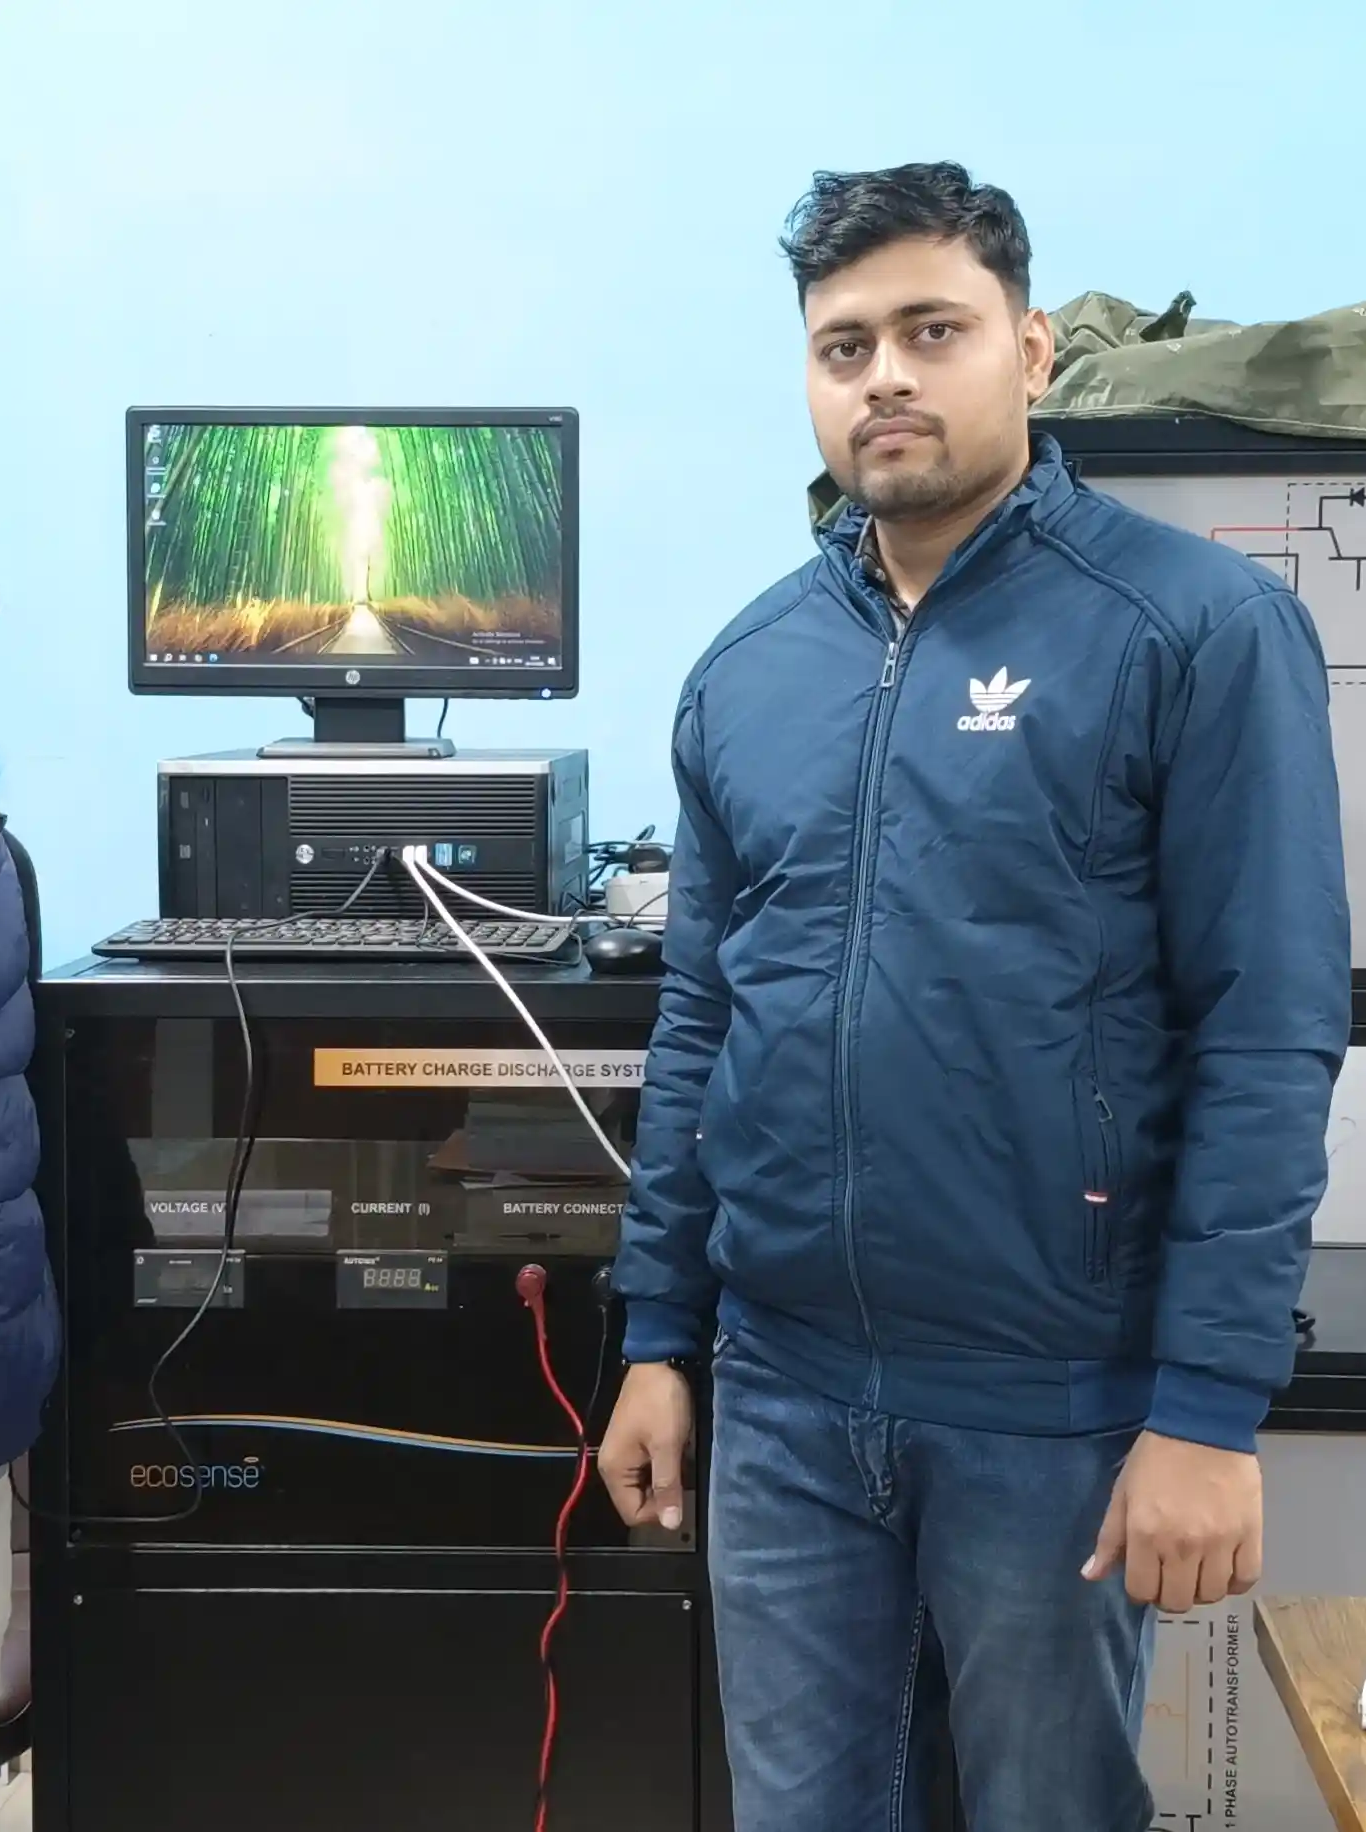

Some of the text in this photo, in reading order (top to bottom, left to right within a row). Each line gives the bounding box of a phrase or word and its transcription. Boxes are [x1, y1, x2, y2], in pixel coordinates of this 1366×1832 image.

[957, 712, 1016, 731] adidas
[342, 1063, 418, 1076] BATTERY
[422, 1063, 493, 1077] CHARGE
[151, 1202, 208, 1213] VOLTAGE
[351, 1203, 430, 1215] CURRENT (I)
[503, 1203, 561, 1214] BATTERY
[130, 1464, 259, 1488] ecosense
[1225, 1614, 1239, 1766] AUTOTRANSFORMER
[1225, 1769, 1237, 1818] PHASE
